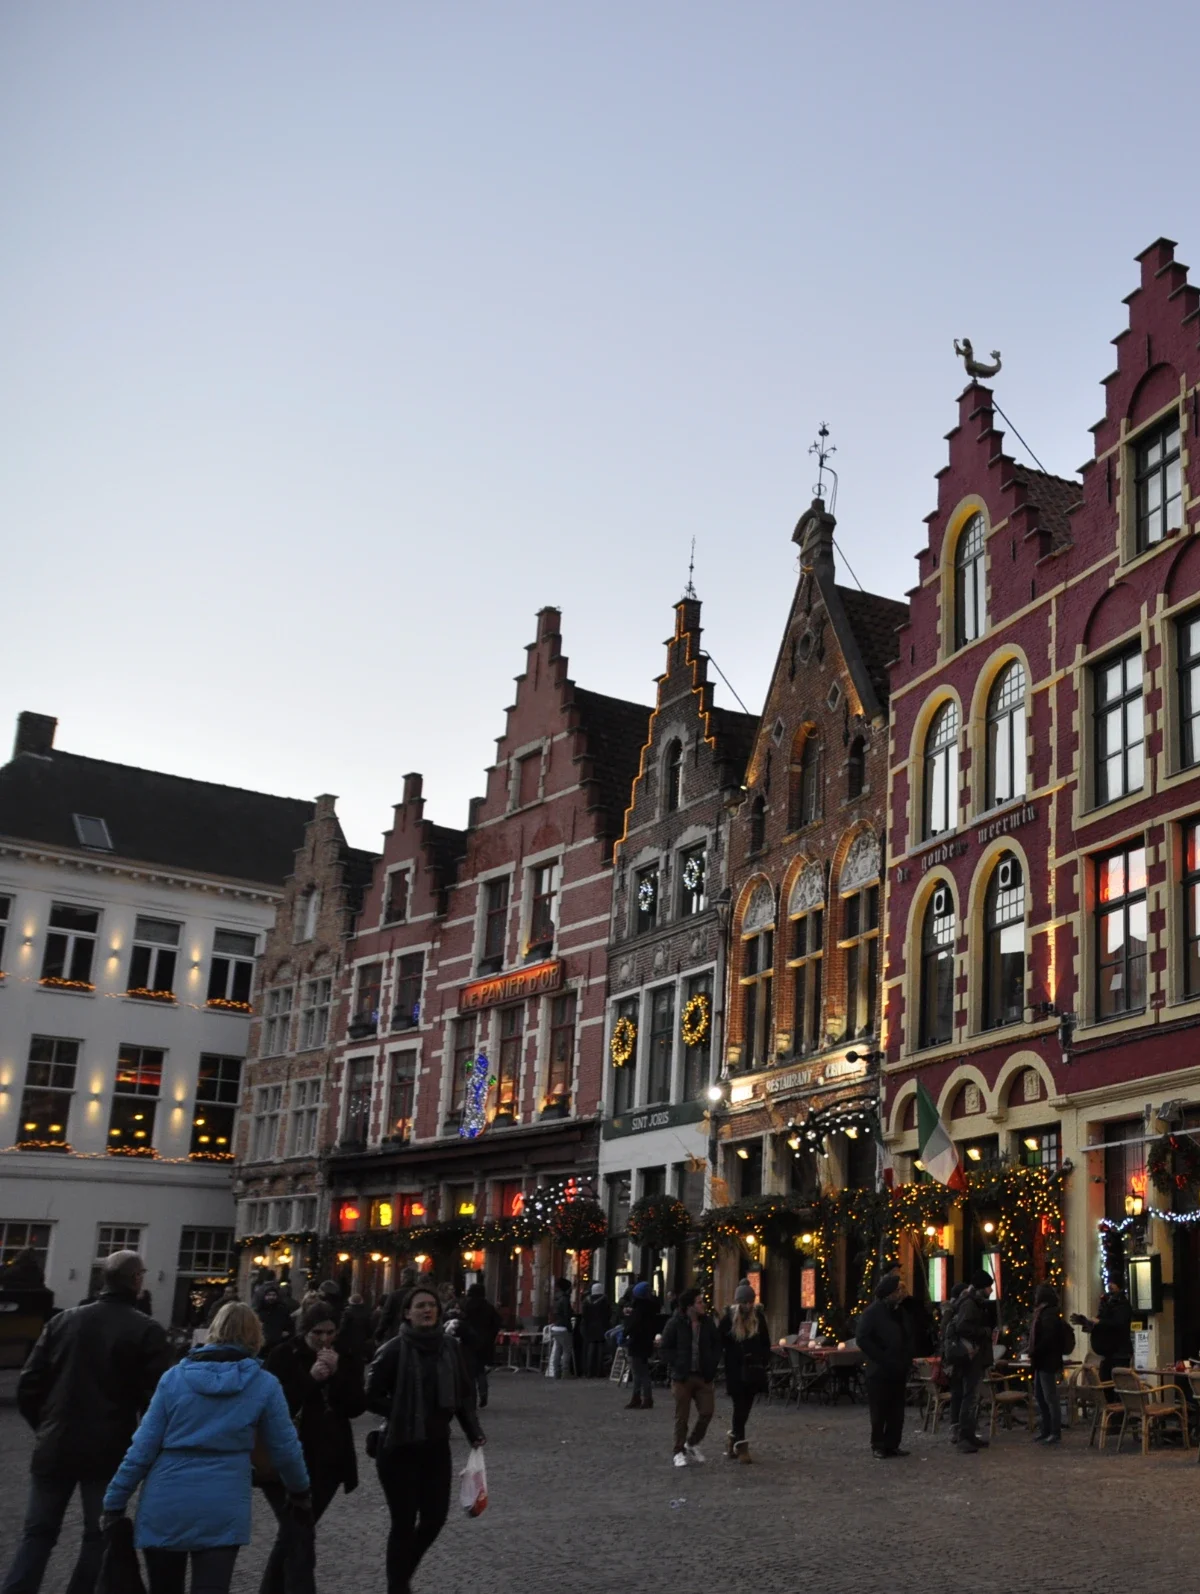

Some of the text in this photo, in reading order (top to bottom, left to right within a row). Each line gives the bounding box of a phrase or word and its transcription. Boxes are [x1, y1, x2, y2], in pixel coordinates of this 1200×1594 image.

[461, 993, 479, 1009] LE
[480, 974, 527, 1004] PANIER
[765, 1068, 813, 1093] RESTAURANT
[631, 1110, 680, 1131] SINT JORIS
